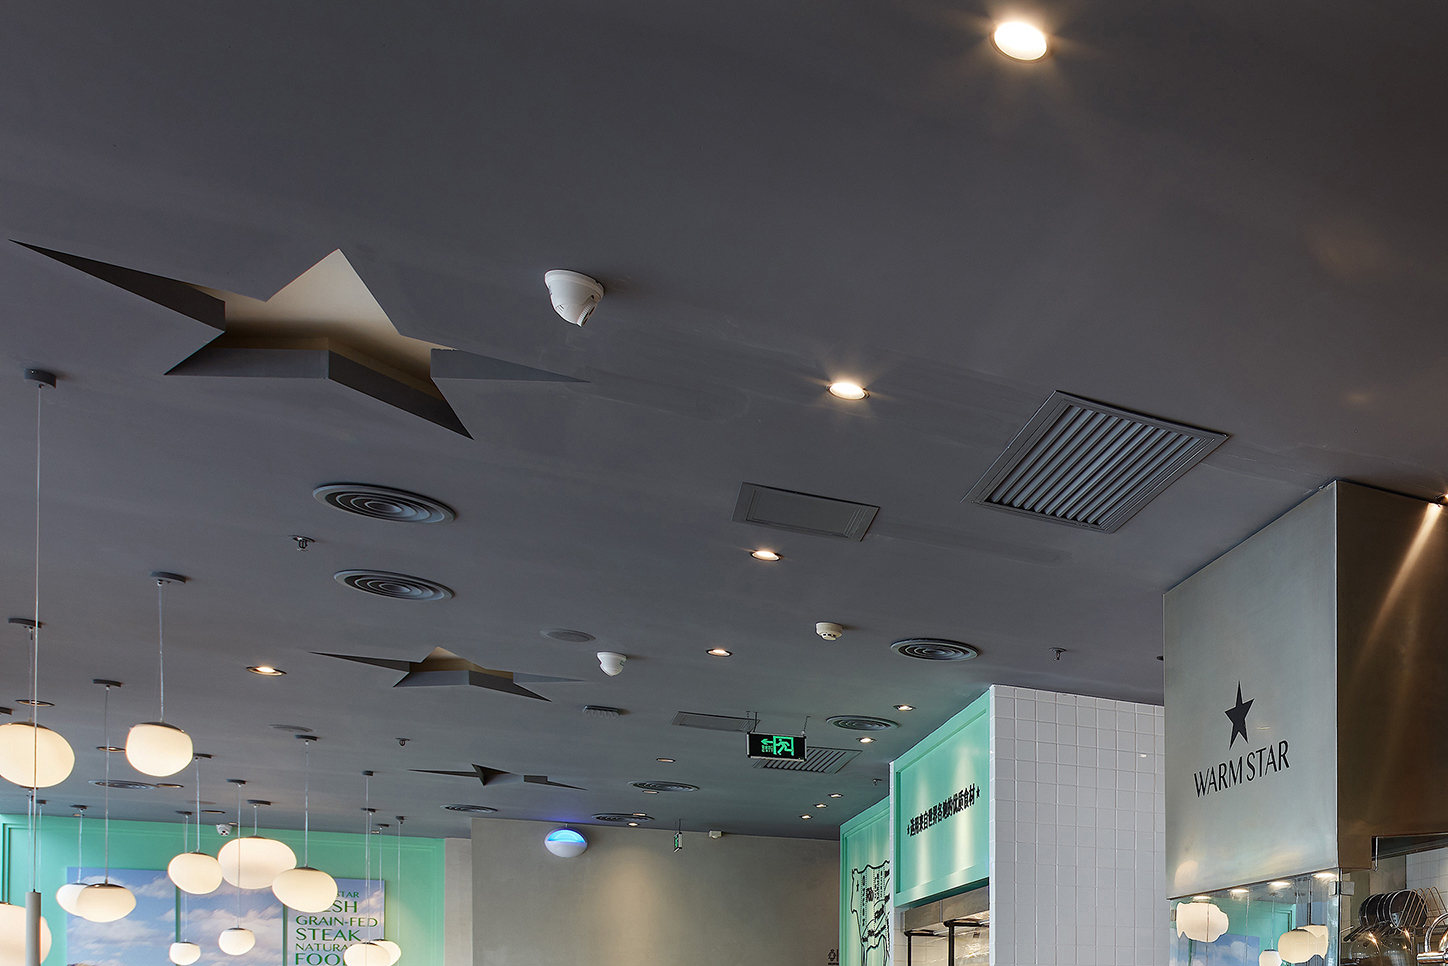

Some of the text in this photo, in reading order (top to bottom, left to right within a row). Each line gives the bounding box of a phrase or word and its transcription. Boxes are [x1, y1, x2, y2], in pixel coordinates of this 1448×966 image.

[295, 915, 378, 927] GRAIN-FED
[295, 927, 361, 942] STEAK
[295, 943, 351, 952] NATURA
[295, 953, 346, 966] FOO
